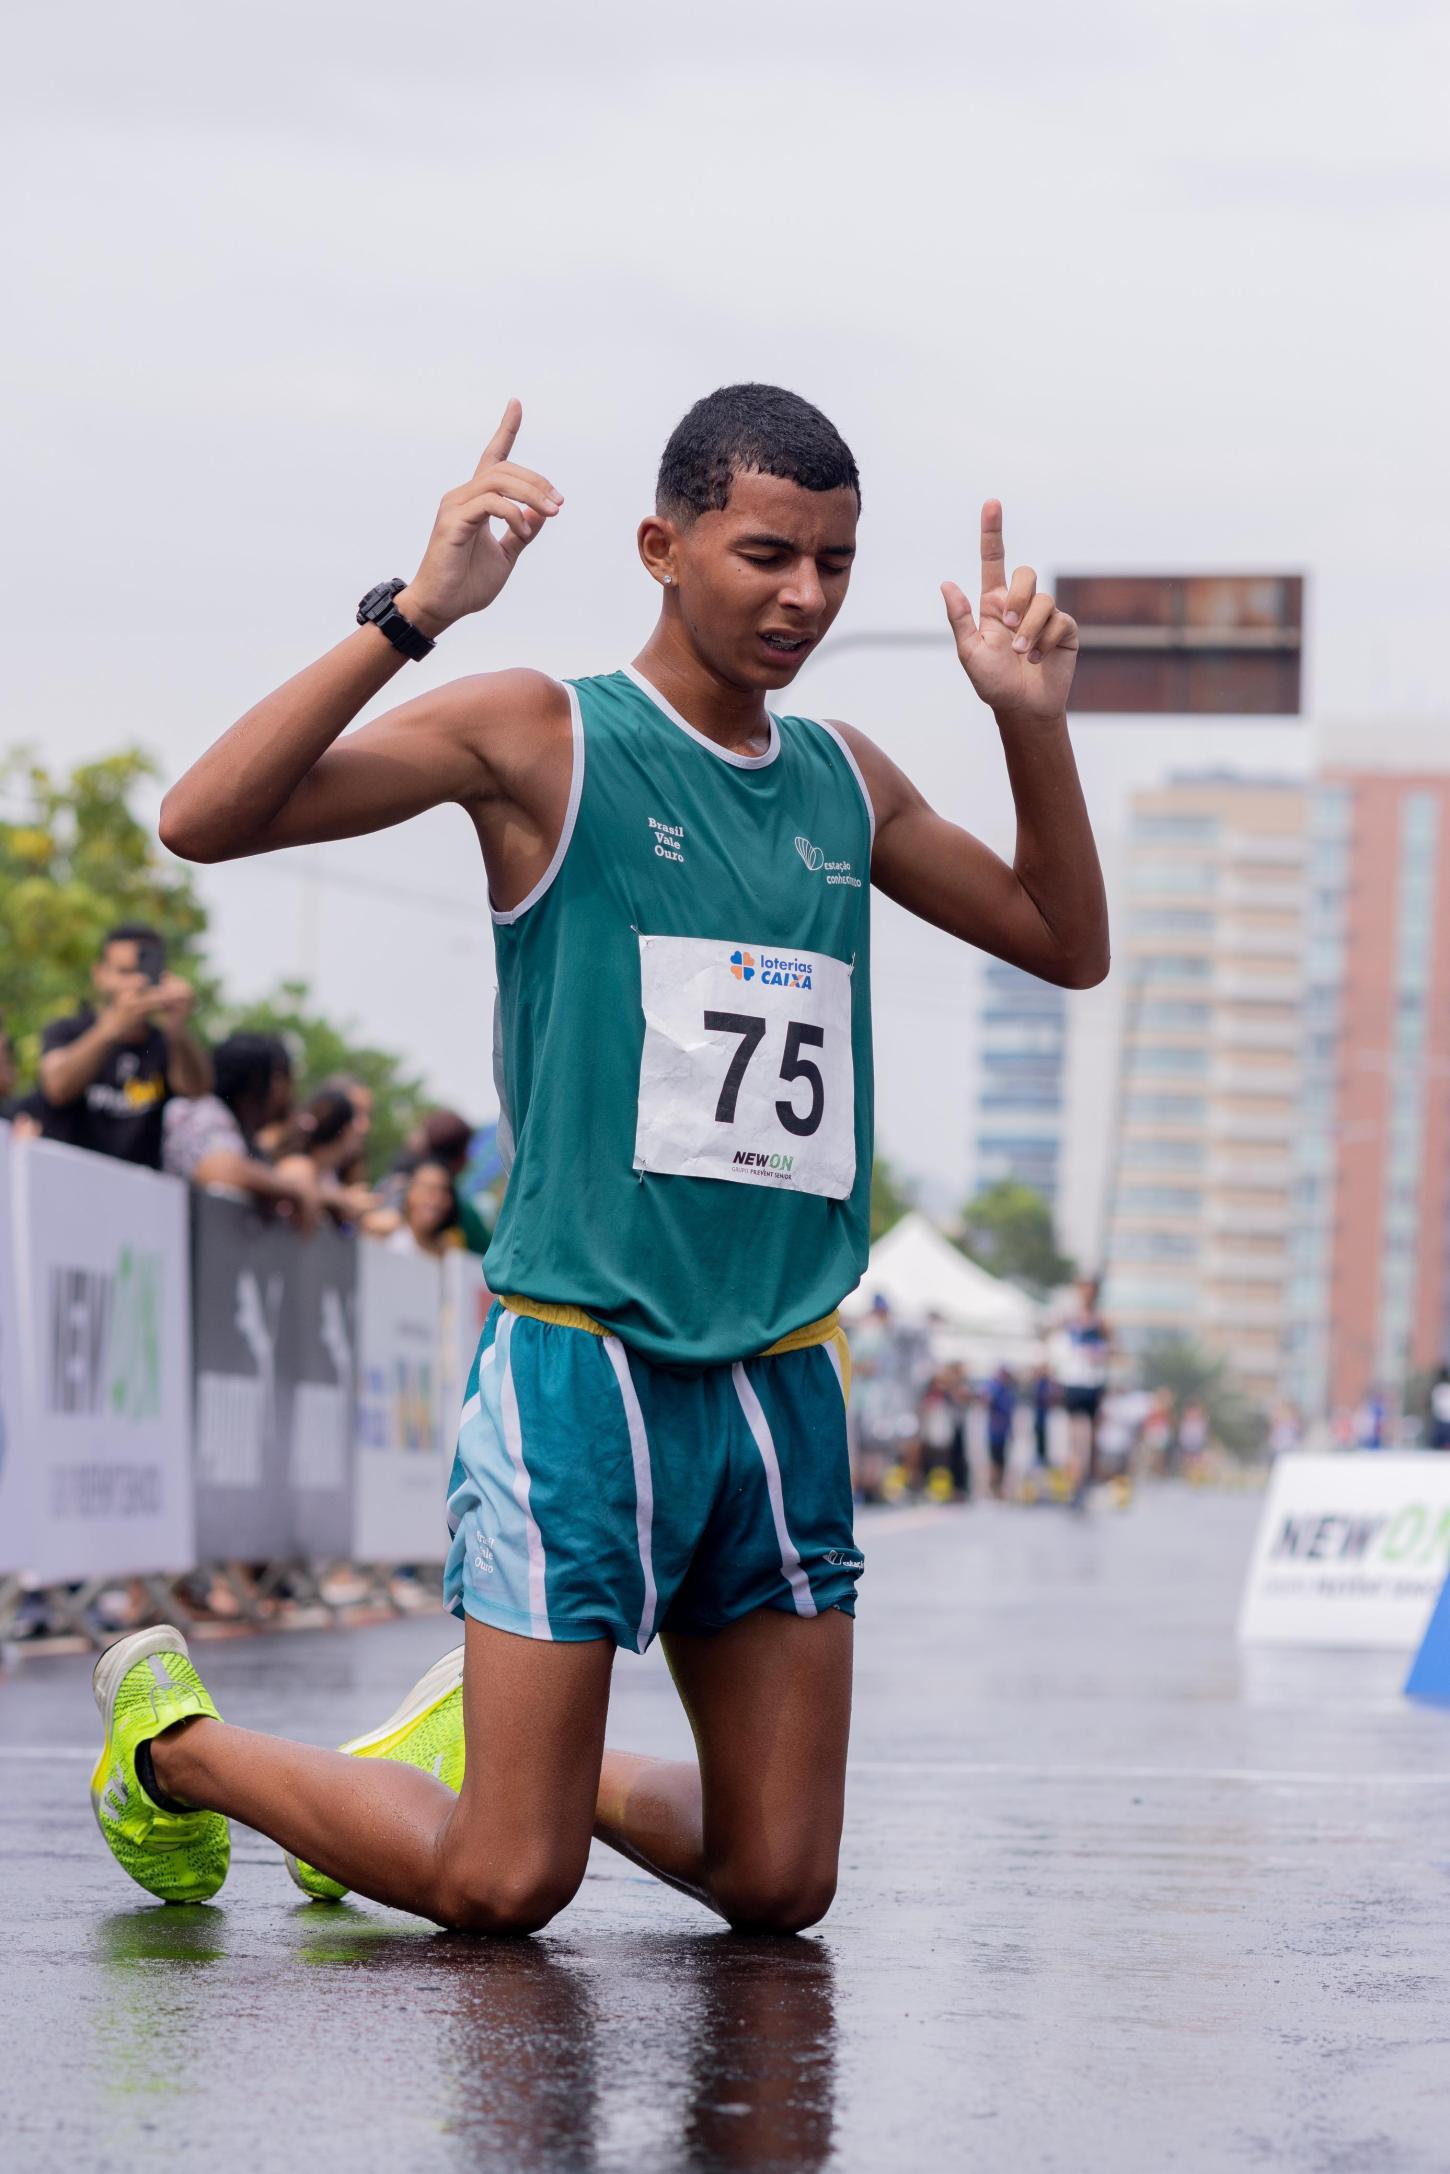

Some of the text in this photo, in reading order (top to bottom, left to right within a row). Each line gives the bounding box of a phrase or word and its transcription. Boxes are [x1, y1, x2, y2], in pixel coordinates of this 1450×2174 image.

[648, 817, 684, 837] Brasil
[654, 832, 681, 850] Vale
[654, 844, 684, 862] Ouro
[760, 955, 813, 974] loterias
[761, 970, 812, 990] CAIXA
[703, 1010, 824, 1136] 75
[732, 1151, 794, 1171] NEWON
[750, 1169, 774, 1178] PREVENT
[774, 1172, 792, 1180] SENIOR
